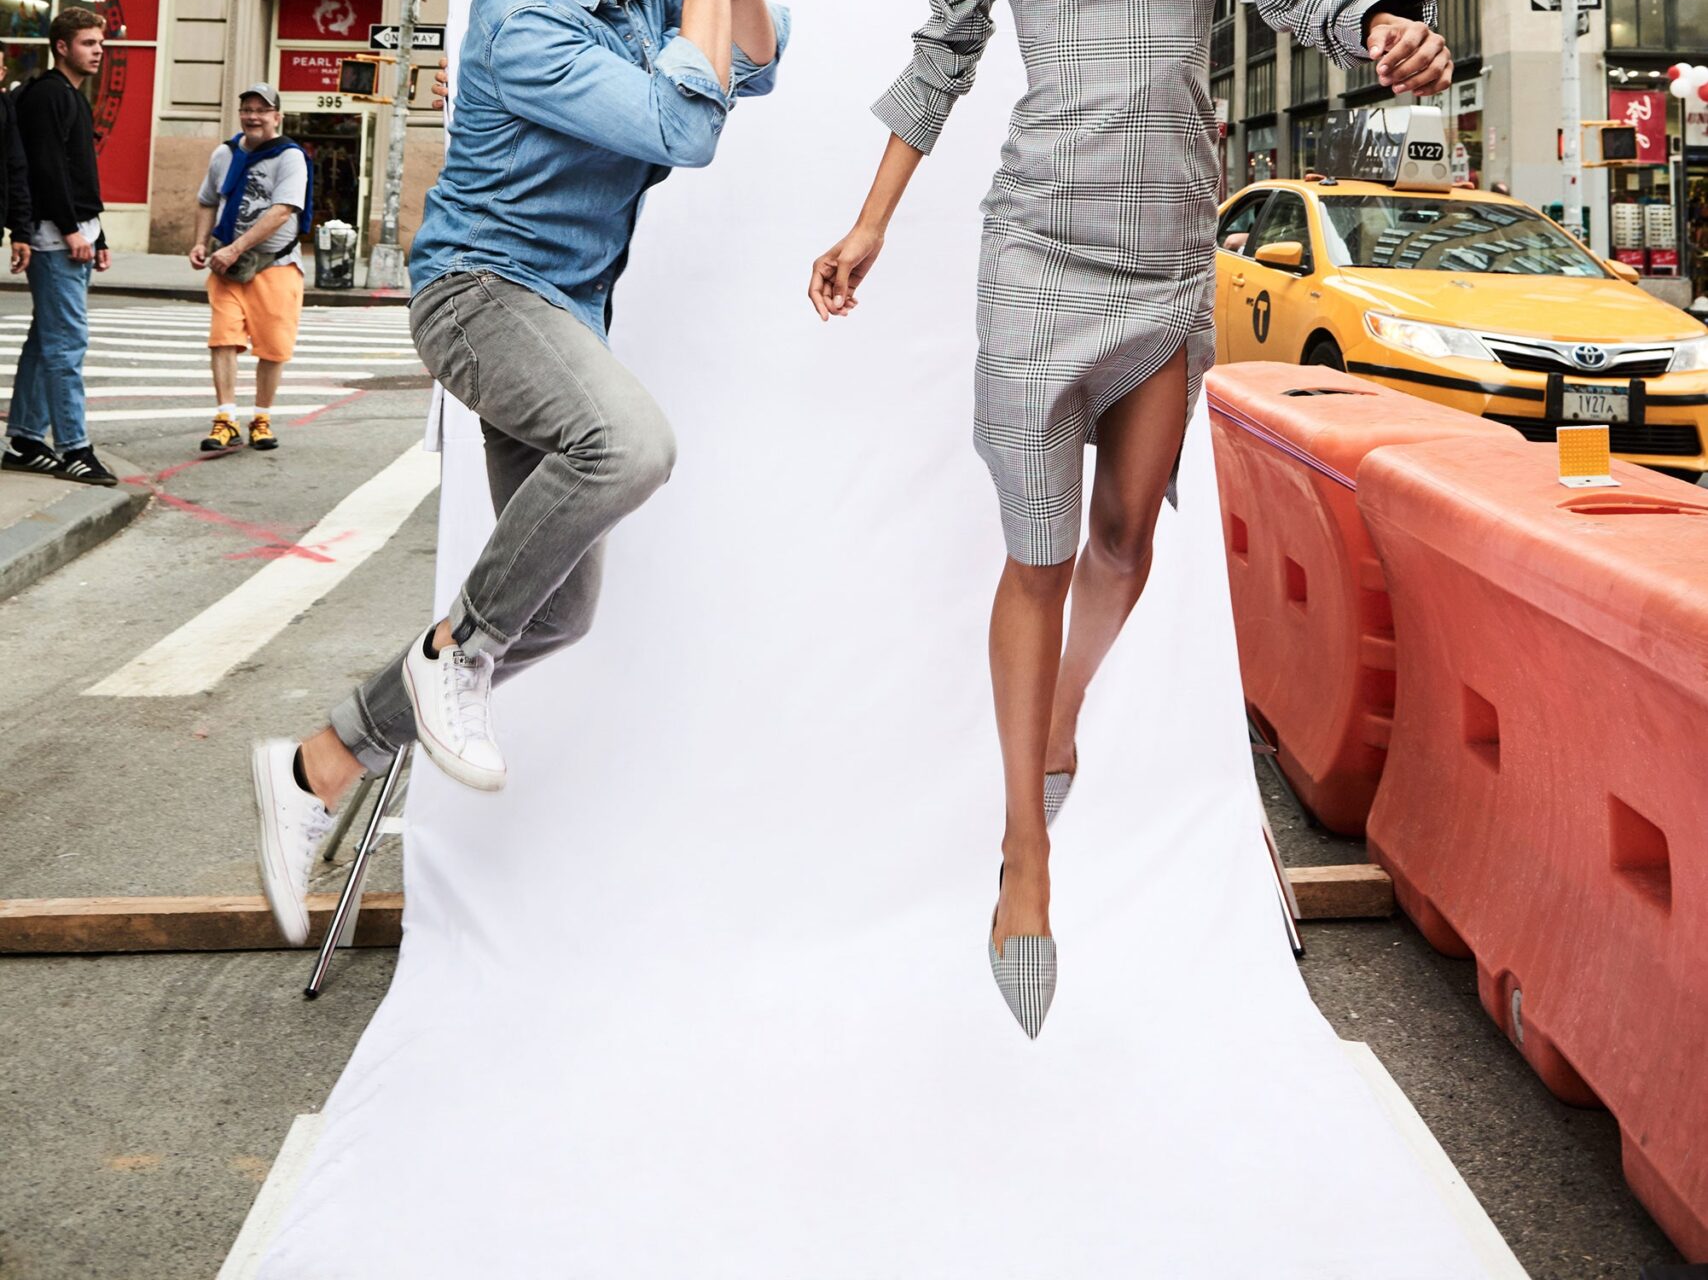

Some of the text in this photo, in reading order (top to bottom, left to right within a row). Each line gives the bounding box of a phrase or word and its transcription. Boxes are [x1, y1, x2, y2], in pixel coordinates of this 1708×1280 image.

[292, 56, 332, 67] PEARL
[317, 96, 342, 108] 395
[1409, 145, 1442, 158] 1Y27
